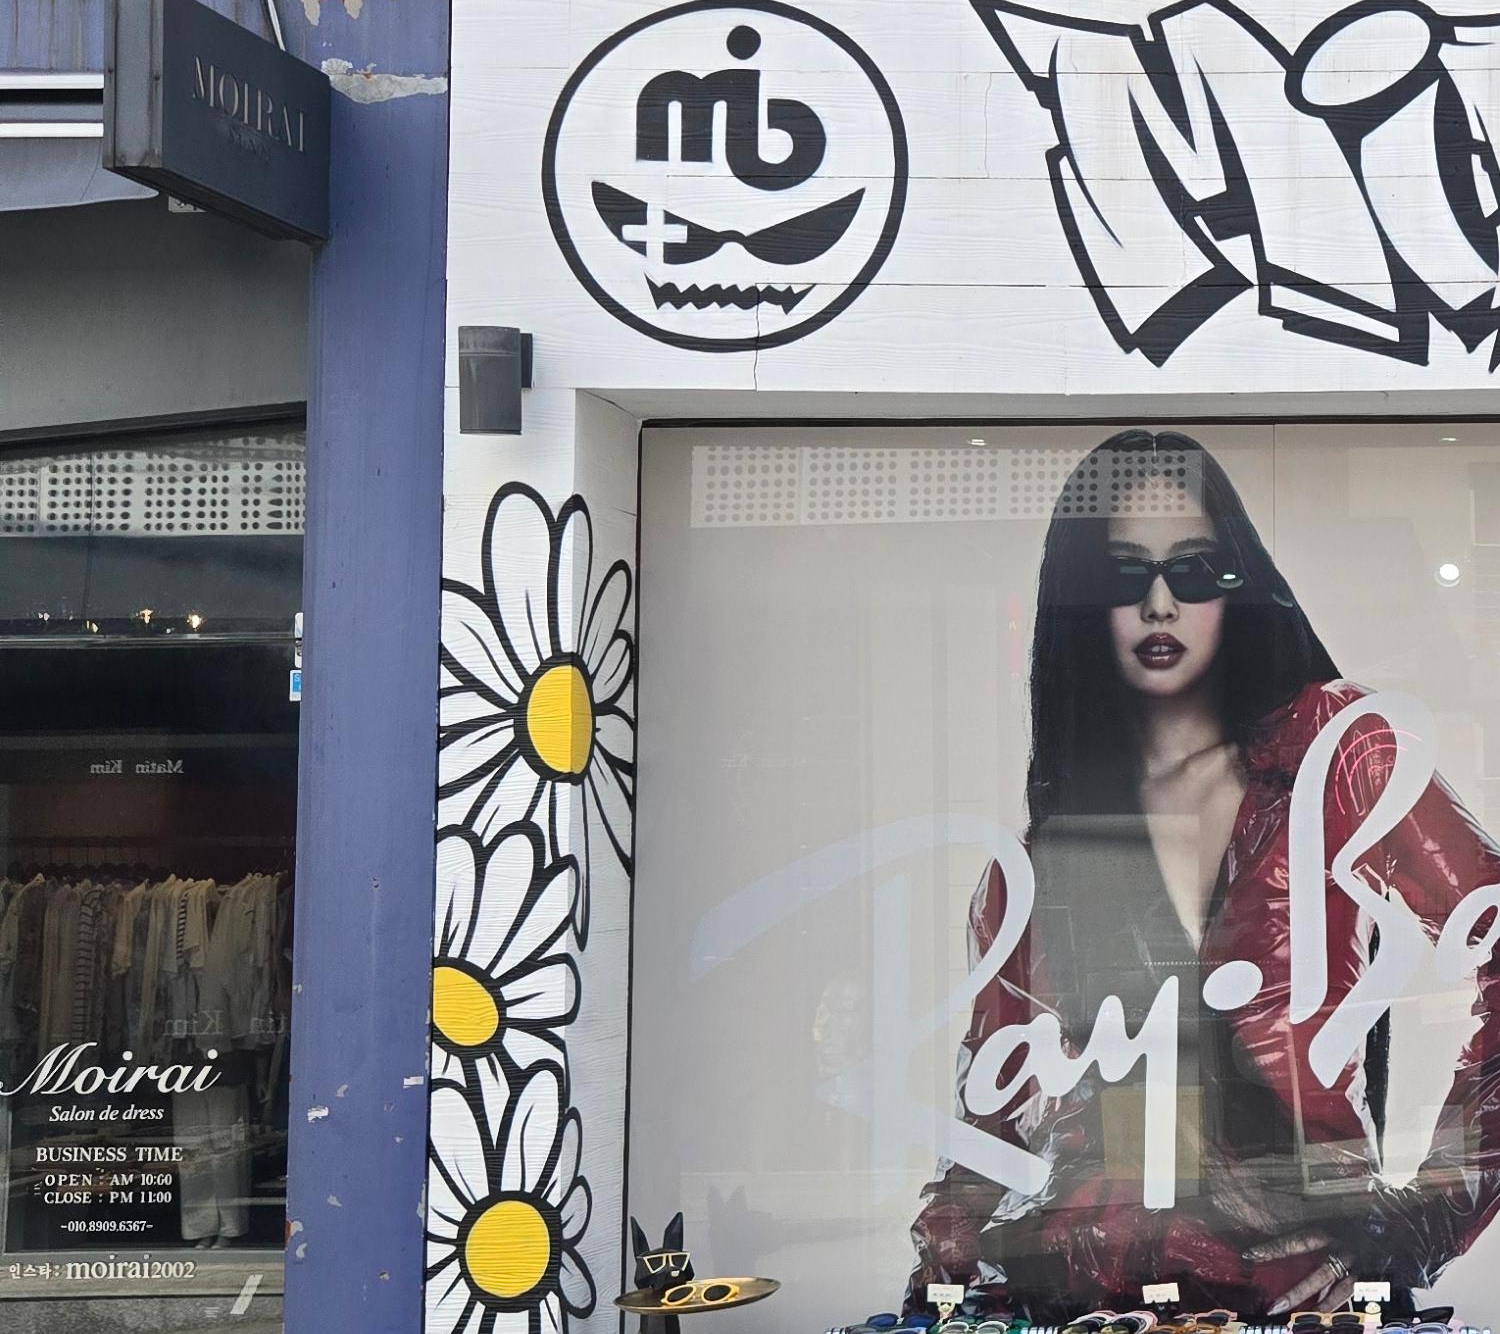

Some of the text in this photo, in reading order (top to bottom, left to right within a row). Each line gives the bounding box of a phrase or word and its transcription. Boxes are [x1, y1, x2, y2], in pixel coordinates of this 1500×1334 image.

[192, 55, 304, 153] MOIRAI
[0, 1042, 222, 1096] Moirai
[49, 1104, 165, 1122] Salon de dress
[36, 1147, 183, 1162] BUSINESS TIME
[44, 1174, 93, 1187] OPEN
[109, 1174, 134, 1186] AM
[44, 1192, 92, 1204] CLOSE
[109, 1192, 133, 1204] PM
[140, 1192, 173, 1204] 11:00
[66, 1253, 196, 1280] moirai2002
